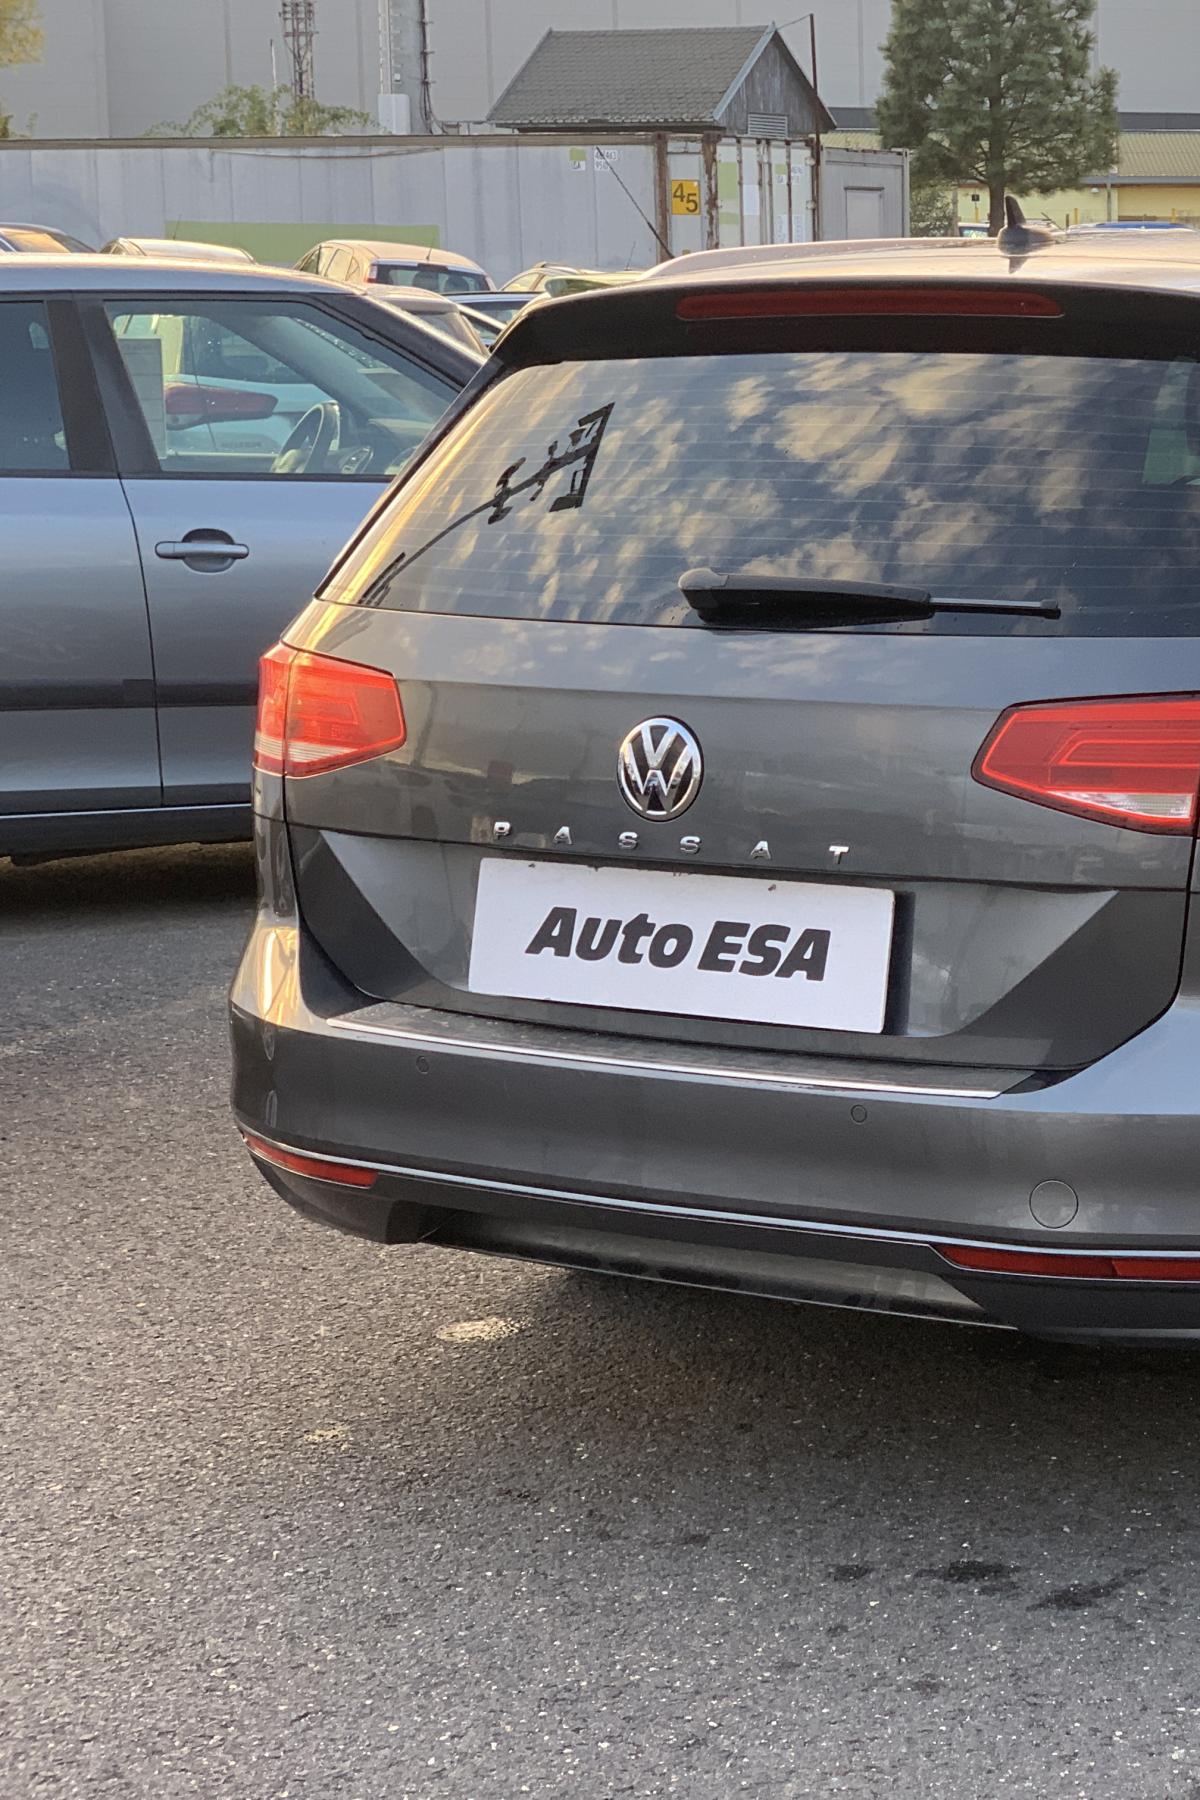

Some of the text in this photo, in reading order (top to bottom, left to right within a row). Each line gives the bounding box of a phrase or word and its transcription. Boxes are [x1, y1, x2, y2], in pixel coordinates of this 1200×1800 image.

[494, 821, 850, 865] PASSAT
[524, 906, 831, 982] Auto ESA
